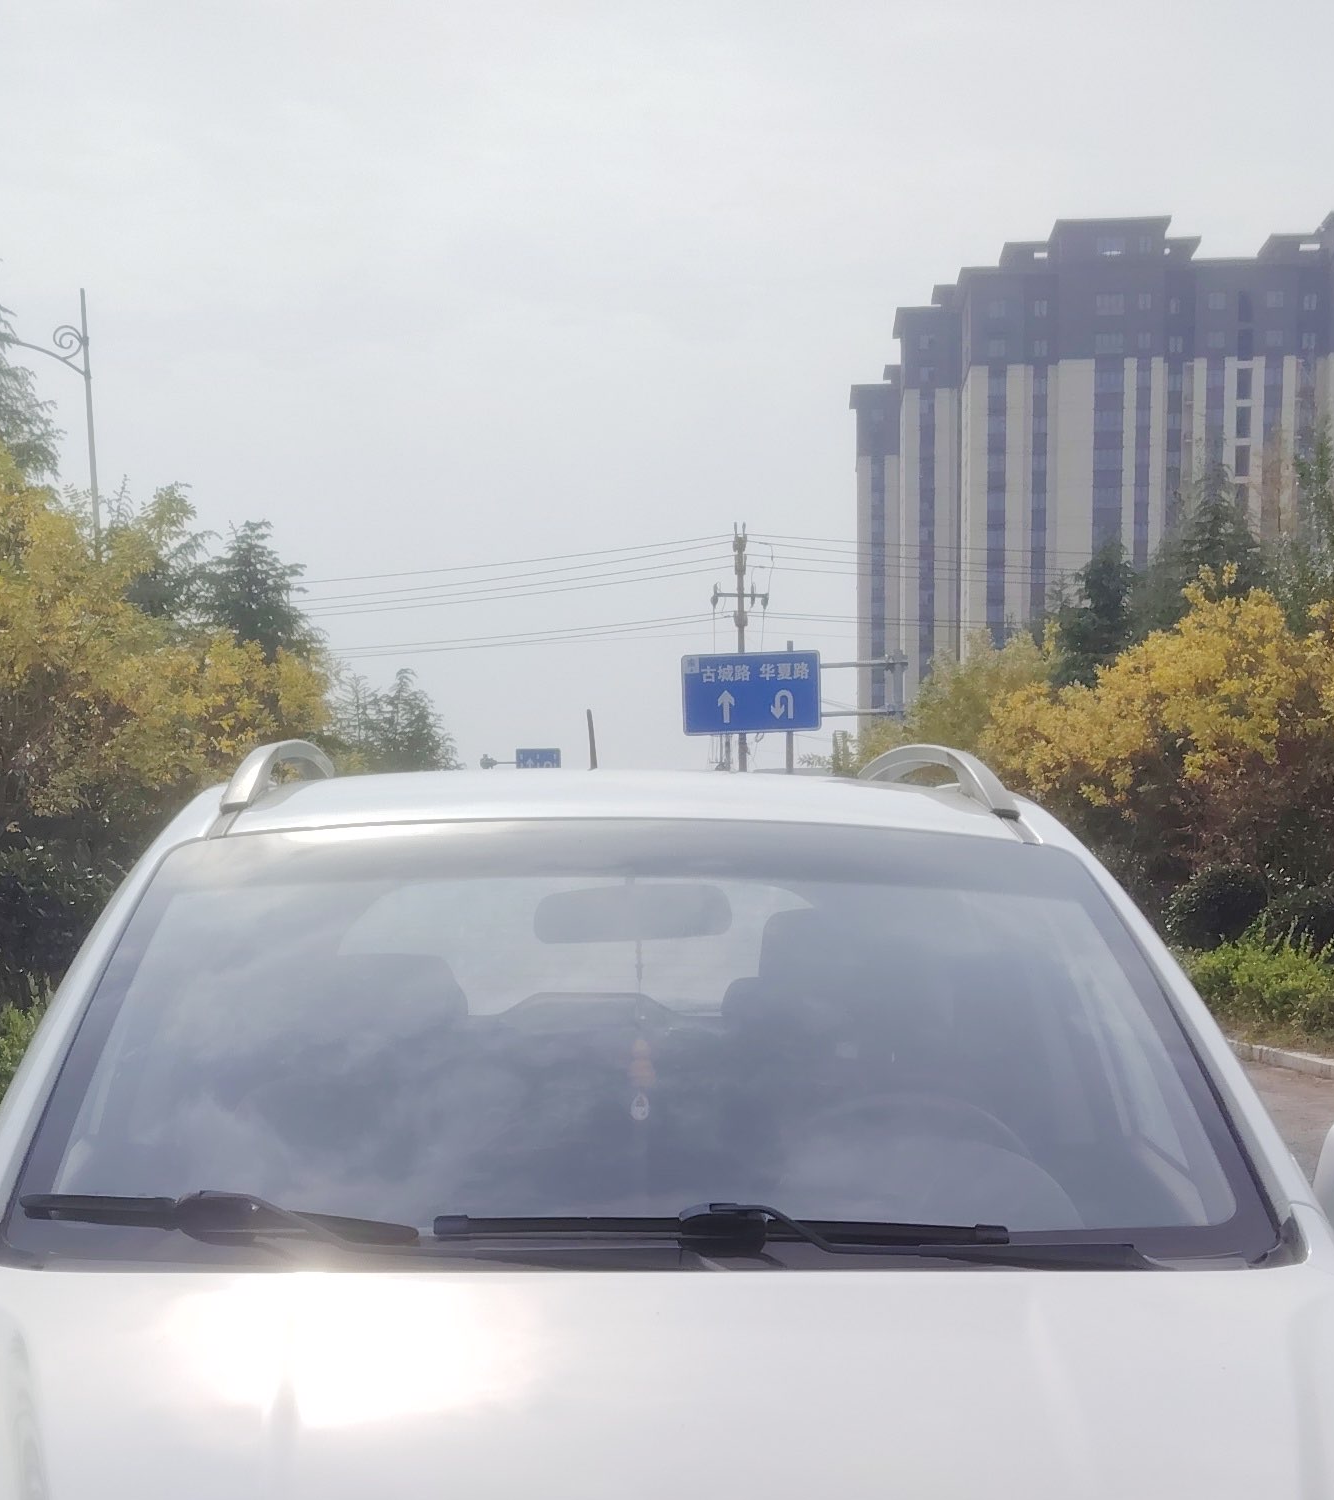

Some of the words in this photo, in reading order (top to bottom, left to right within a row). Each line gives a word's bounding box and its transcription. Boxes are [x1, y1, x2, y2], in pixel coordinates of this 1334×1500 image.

[701, 664, 751, 683] 古城路
[759, 662, 809, 681] 华夏路
